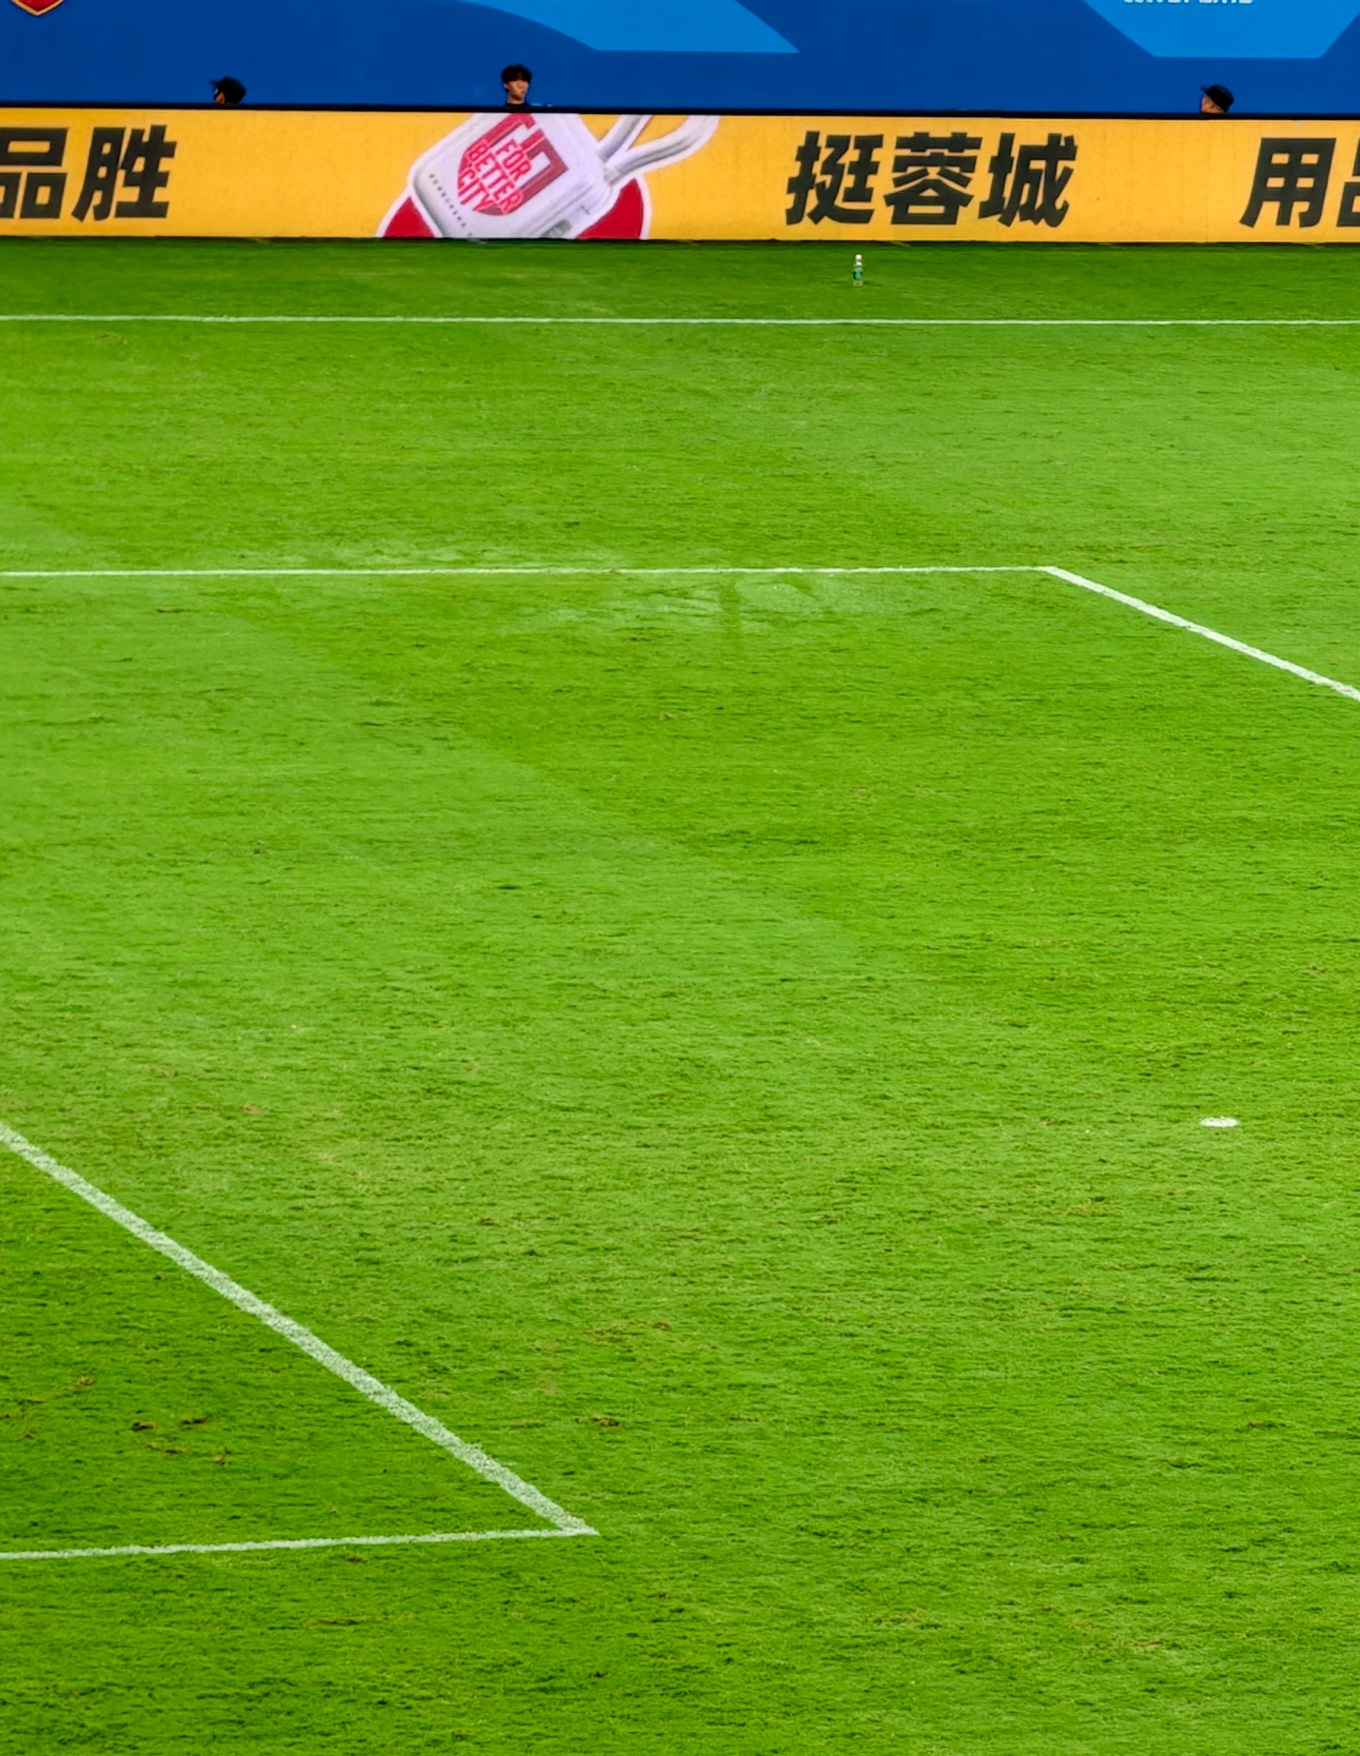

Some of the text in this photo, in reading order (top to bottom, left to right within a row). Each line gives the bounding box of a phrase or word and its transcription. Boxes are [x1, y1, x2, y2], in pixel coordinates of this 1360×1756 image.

[0, 124, 178, 223] 品胜
[458, 166, 498, 212] CITY
[465, 140, 524, 213] BETTER
[495, 138, 532, 182] FOR
[785, 131, 1078, 228] 挺蓉城
